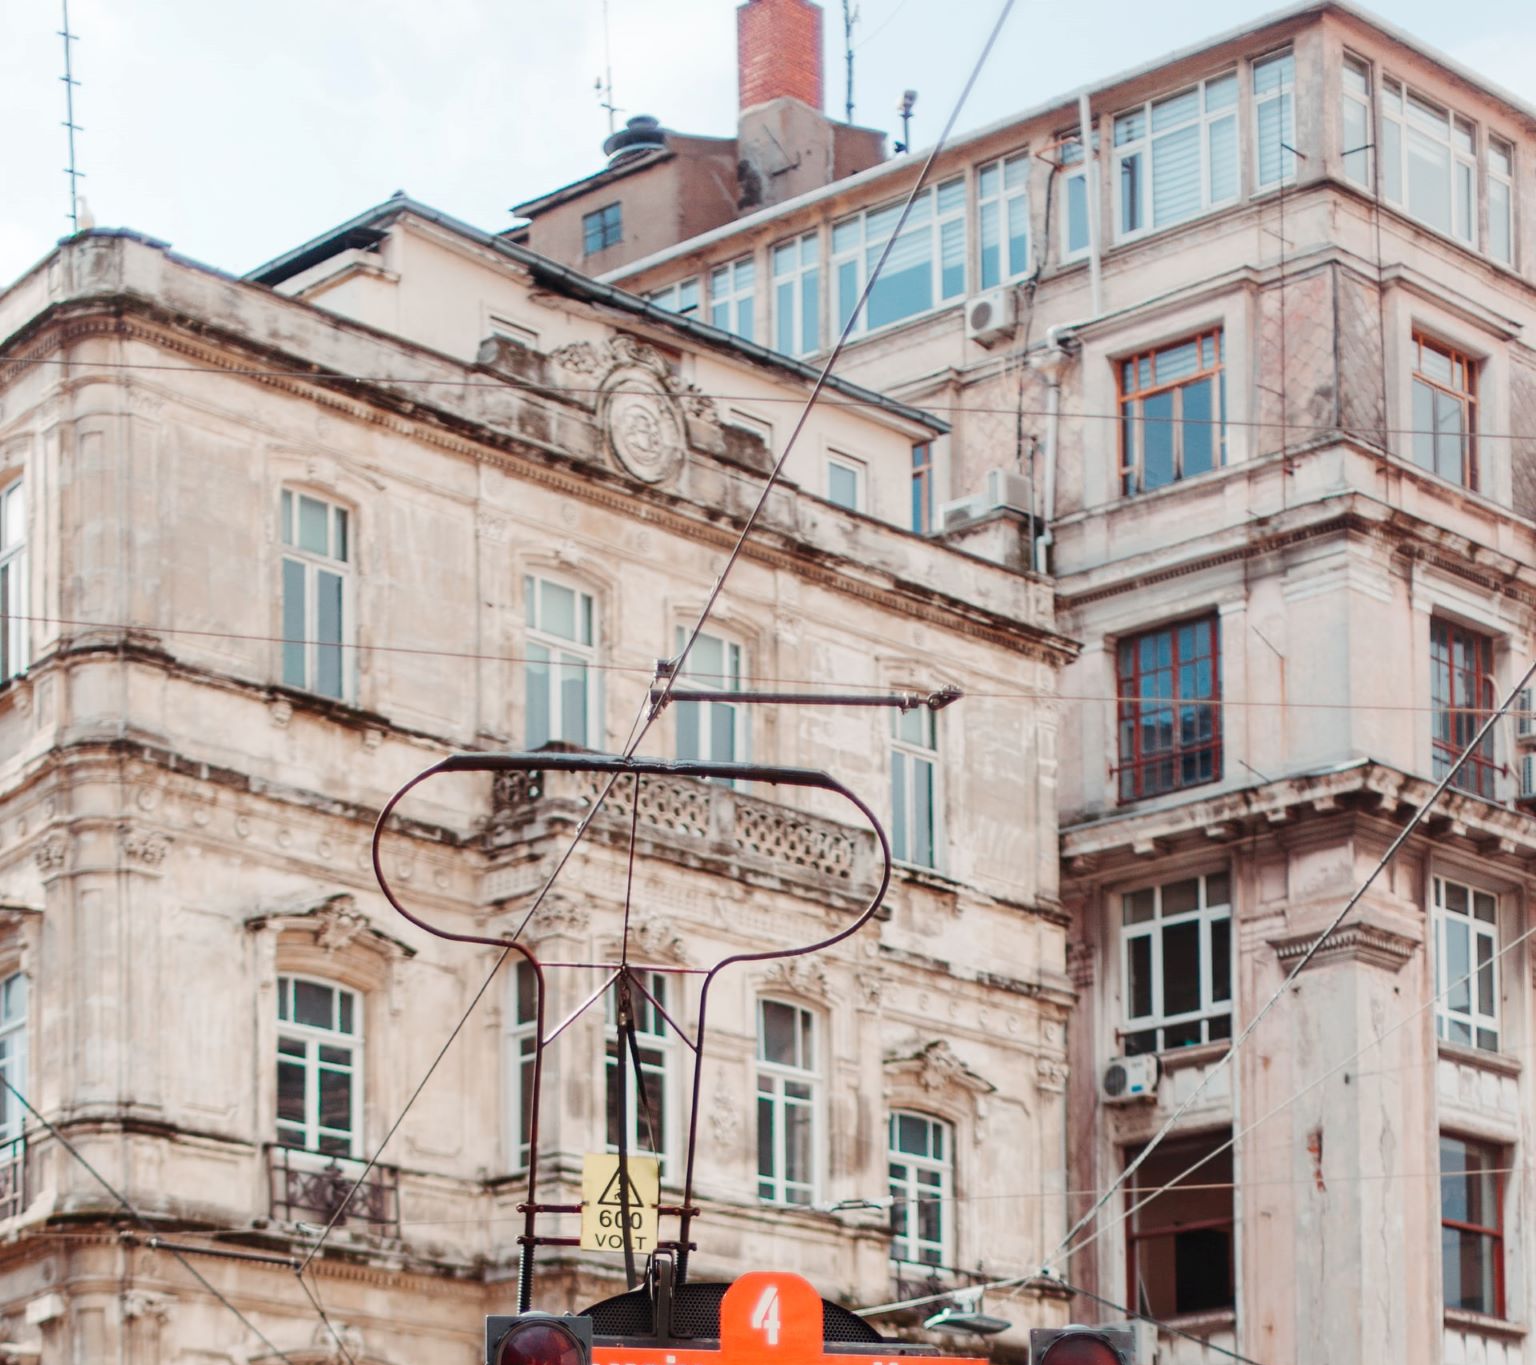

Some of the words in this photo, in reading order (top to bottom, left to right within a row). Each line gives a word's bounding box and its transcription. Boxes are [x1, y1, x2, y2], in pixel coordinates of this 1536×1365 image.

[598, 1209, 643, 1230] 600
[594, 1232, 647, 1251] VOT
[751, 1285, 781, 1346] 4
